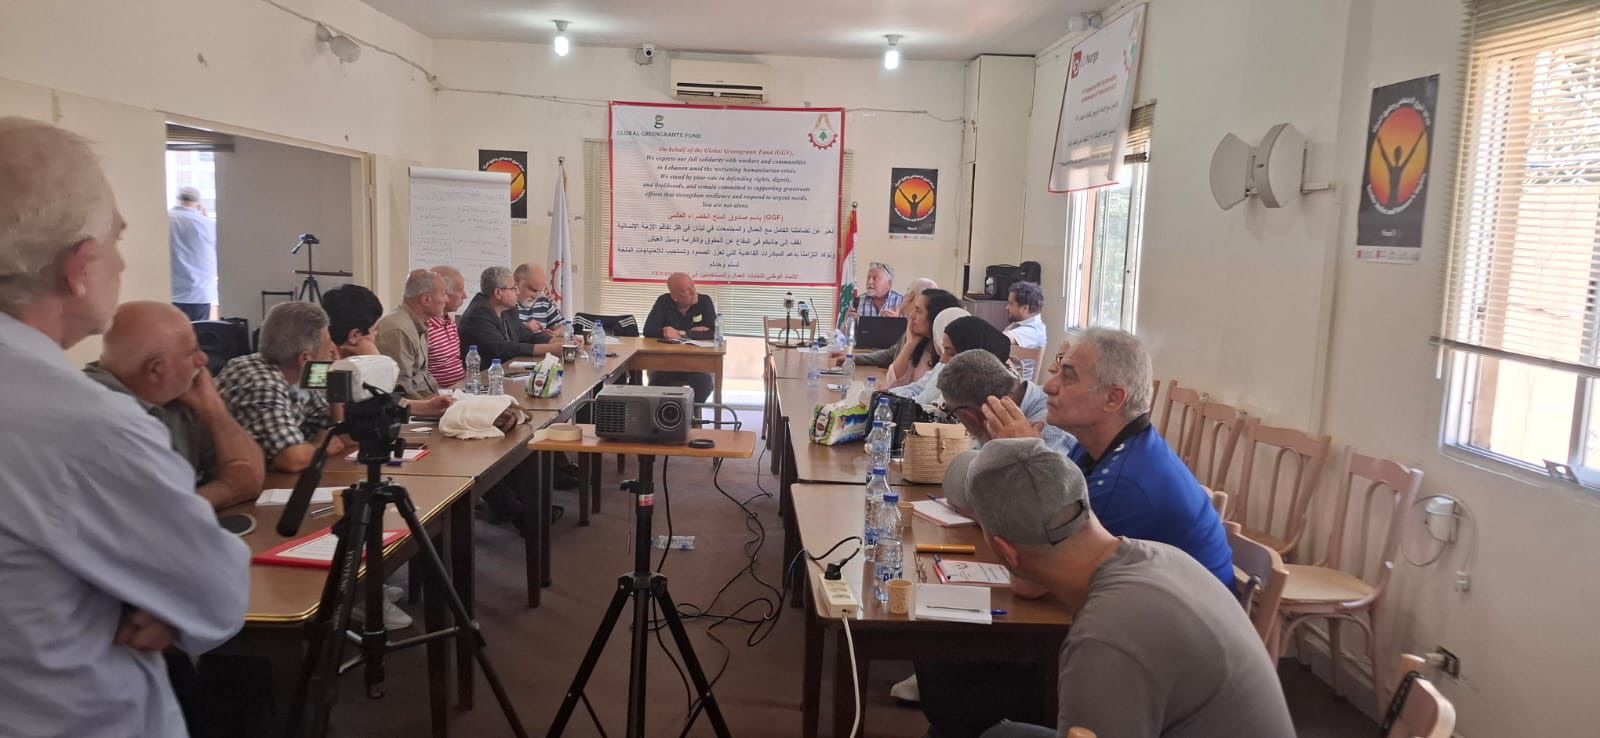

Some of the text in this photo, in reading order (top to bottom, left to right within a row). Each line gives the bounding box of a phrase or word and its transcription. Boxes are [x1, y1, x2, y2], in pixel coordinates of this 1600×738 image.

[712, 213, 726, 221] المنح
[728, 213, 748, 221] صندوق
[764, 214, 784, 222] (GGF)
[682, 224, 691, 232] في
[706, 225, 714, 233] في
[716, 225, 746, 233] والمجتمعات
[764, 227, 772, 235] مع
